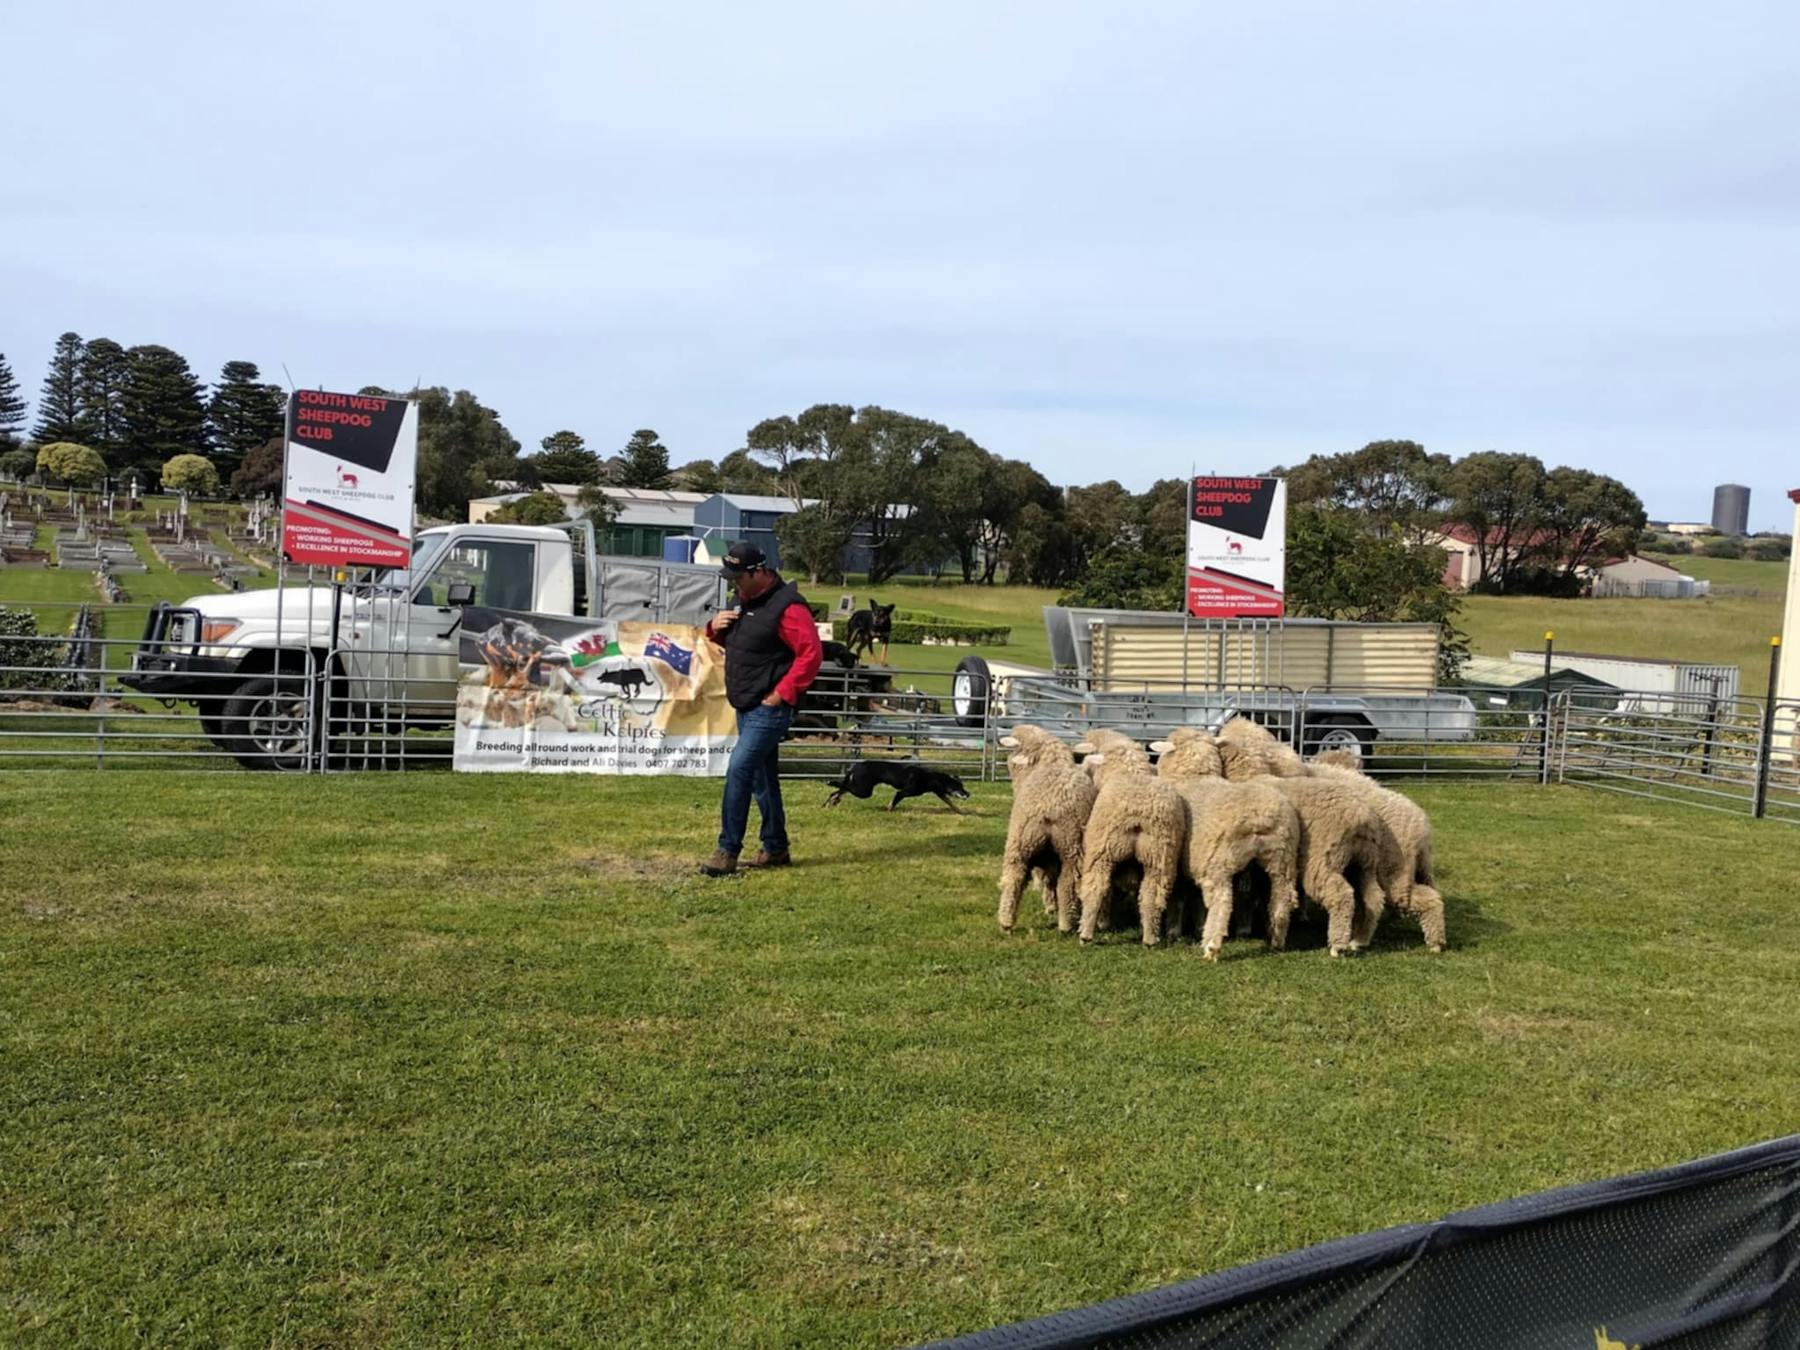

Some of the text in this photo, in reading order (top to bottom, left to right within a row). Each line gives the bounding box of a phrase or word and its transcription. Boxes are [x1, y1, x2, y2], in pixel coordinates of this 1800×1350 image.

[299, 391, 389, 412] SOUTH WEST
[297, 407, 372, 427] SHEEPDOG
[296, 425, 333, 440] CLUB
[1197, 478, 1263, 490] SOUTH WEST
[1196, 491, 1252, 504] SHEEPDOG
[1195, 505, 1223, 517] CLUB
[296, 534, 374, 546] WORKING SHEEPDOGS
[296, 542, 339, 552] EXCELLENCE
[348, 547, 403, 557] STOCKMANSHIP
[577, 702, 632, 720] Celtic
[603, 721, 667, 742] Kelpies
[476, 741, 523, 754] Breeding
[570, 744, 596, 753] work
[597, 744, 617, 754] and
[618, 744, 637, 754] trial
[663, 745, 677, 754] for
[678, 744, 707, 756] sheep
[708, 745, 725, 754] and
[531, 756, 568, 767] Richard
[570, 757, 590, 767] and
[592, 757, 606, 767] Ali
[645, 759, 669, 768] 0407
[671, 759, 688, 768] 702
[690, 759, 707, 768] 783
